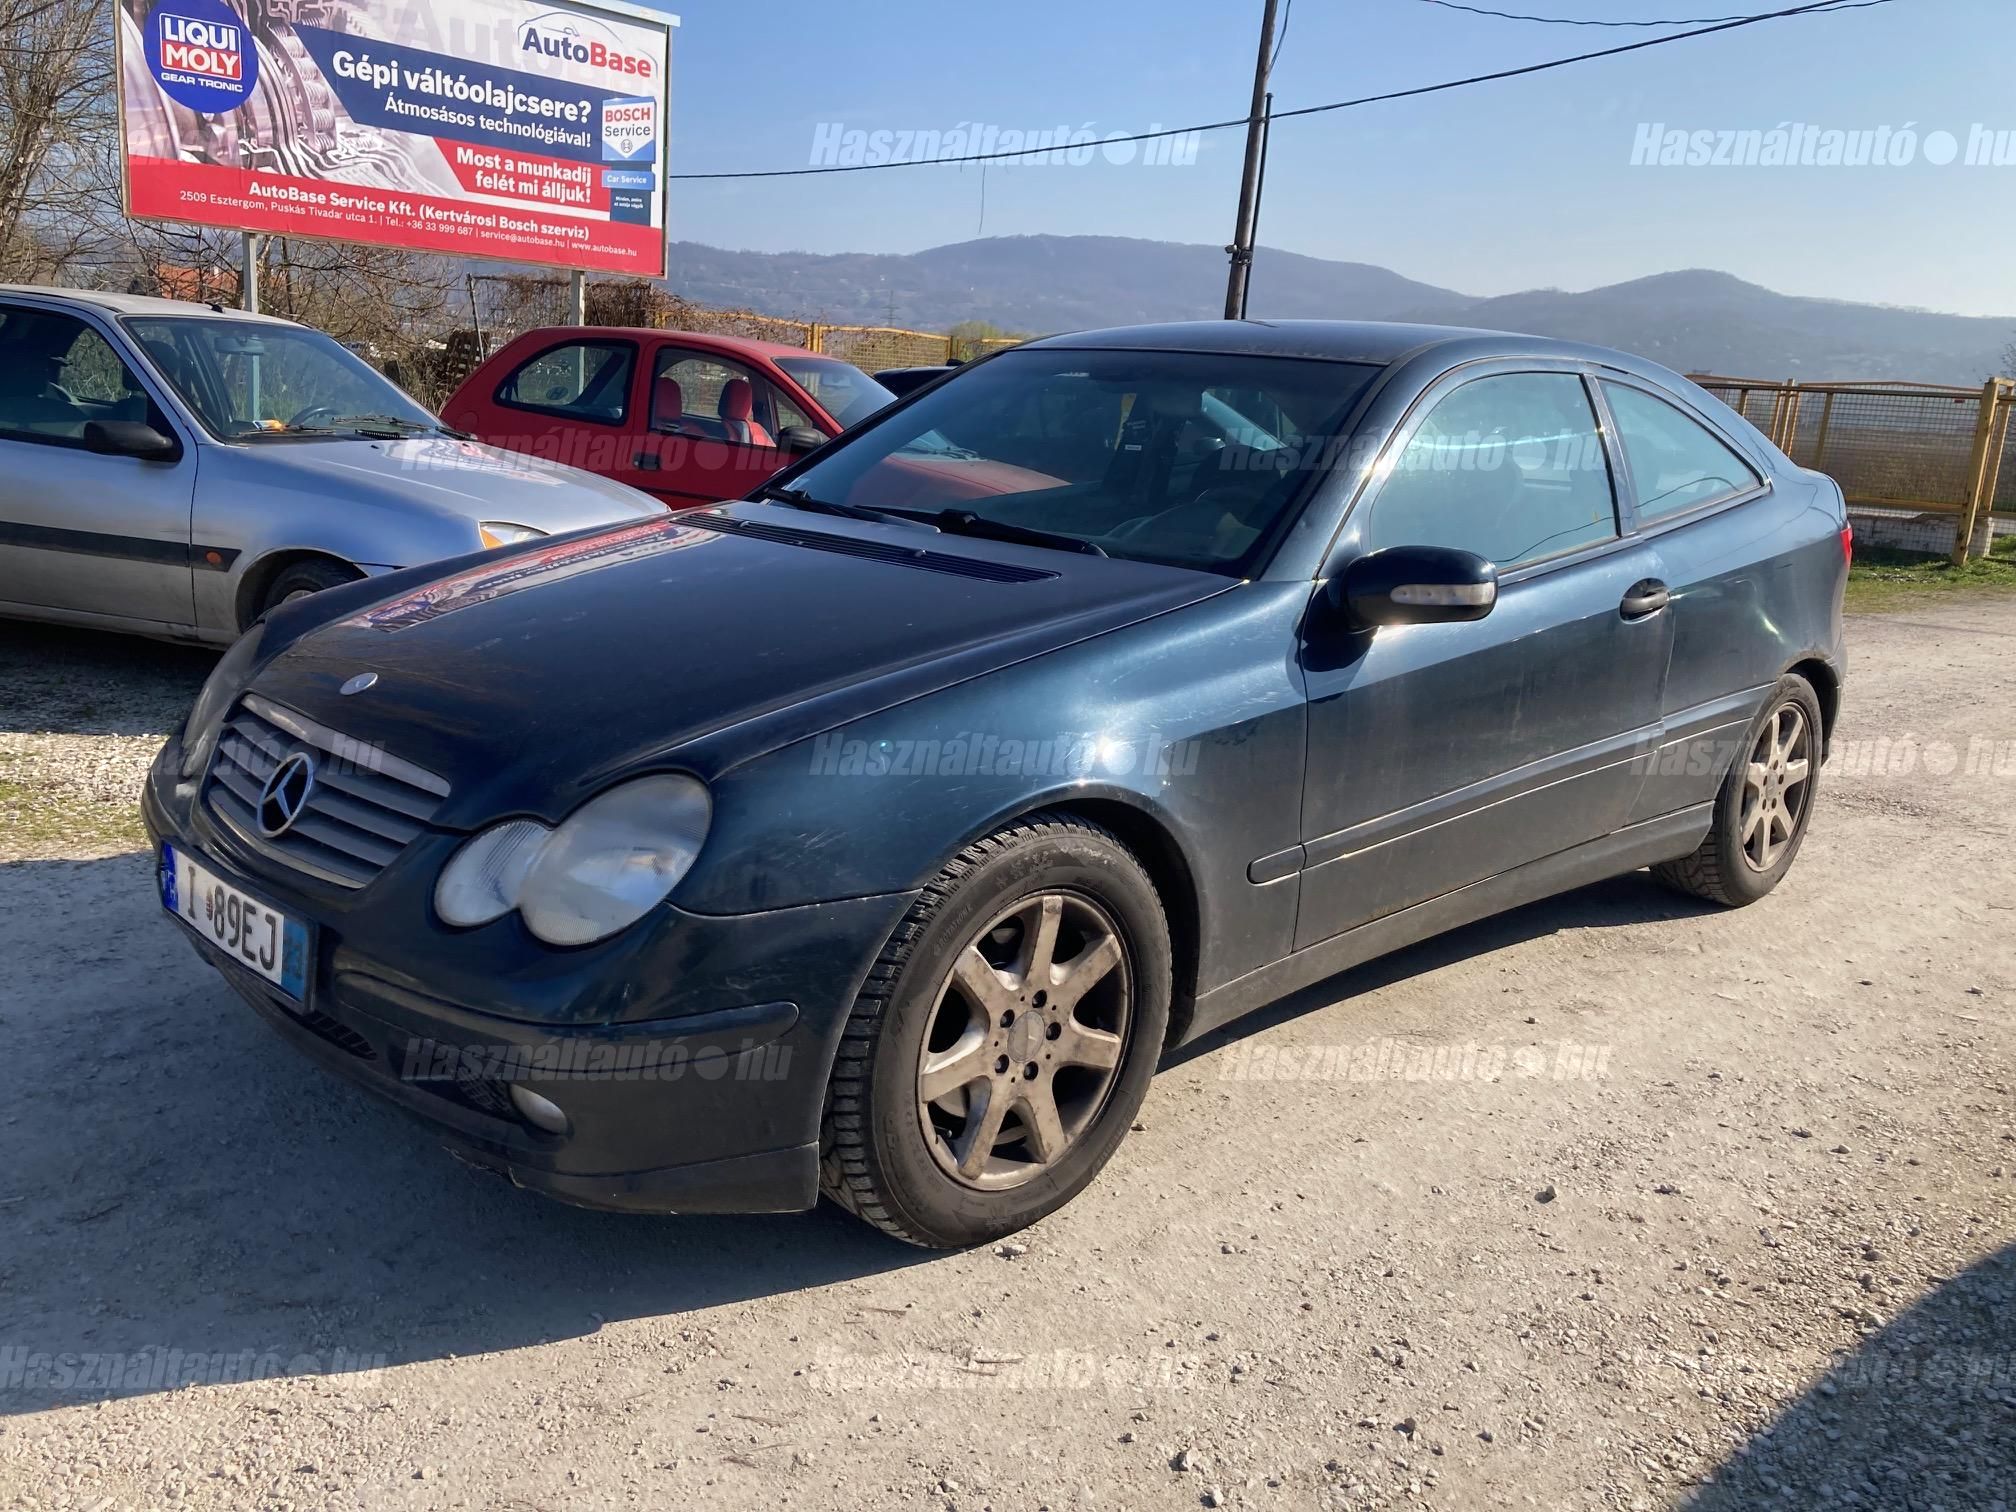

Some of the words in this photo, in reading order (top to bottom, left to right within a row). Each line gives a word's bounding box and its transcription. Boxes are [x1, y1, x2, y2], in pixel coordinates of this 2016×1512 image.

[164, 18, 237, 51] LIQUI
[164, 45, 240, 77] MOLY
[522, 27, 651, 78] AutoBase
[161, 72, 195, 85] GEAR
[198, 78, 243, 93] TRONIC
[332, 51, 398, 89] Gépi
[404, 68, 592, 123] váltóolajcsere?
[385, 92, 475, 127] Átmosásos
[479, 114, 591, 147] technológiával!
[604, 124, 651, 137] Service
[605, 107, 651, 122] BOSCH
[457, 147, 501, 171] Most
[505, 158, 513, 172] a
[517, 160, 592, 188] munkadíj
[607, 174, 620, 183] Car
[621, 175, 647, 184] Service
[475, 170, 515, 192] felét
[518, 179, 538, 196] mi
[542, 180, 591, 203] álljuk!
[180, 191, 207, 203] 2509
[210, 194, 268, 211] Esztergom,
[271, 202, 306, 215] Puskás
[309, 207, 343, 219] Tivadar
[345, 211, 366, 223] utca
[407, 219, 422, 230] +36
[426, 222, 437, 232] 33
[439, 224, 455, 234] 999
[457, 226, 473, 236] 687
[480, 230, 565, 248] service@autobase.hu
[571, 241, 637, 257] www.autobase.hu
[249, 182, 326, 204] AutoBase
[330, 193, 385, 212] Service
[389, 201, 415, 216] Kft.
[420, 204, 496, 227] (Kertvárosi
[500, 216, 538, 233] Bosch
[541, 225, 589, 241] szerviz)
